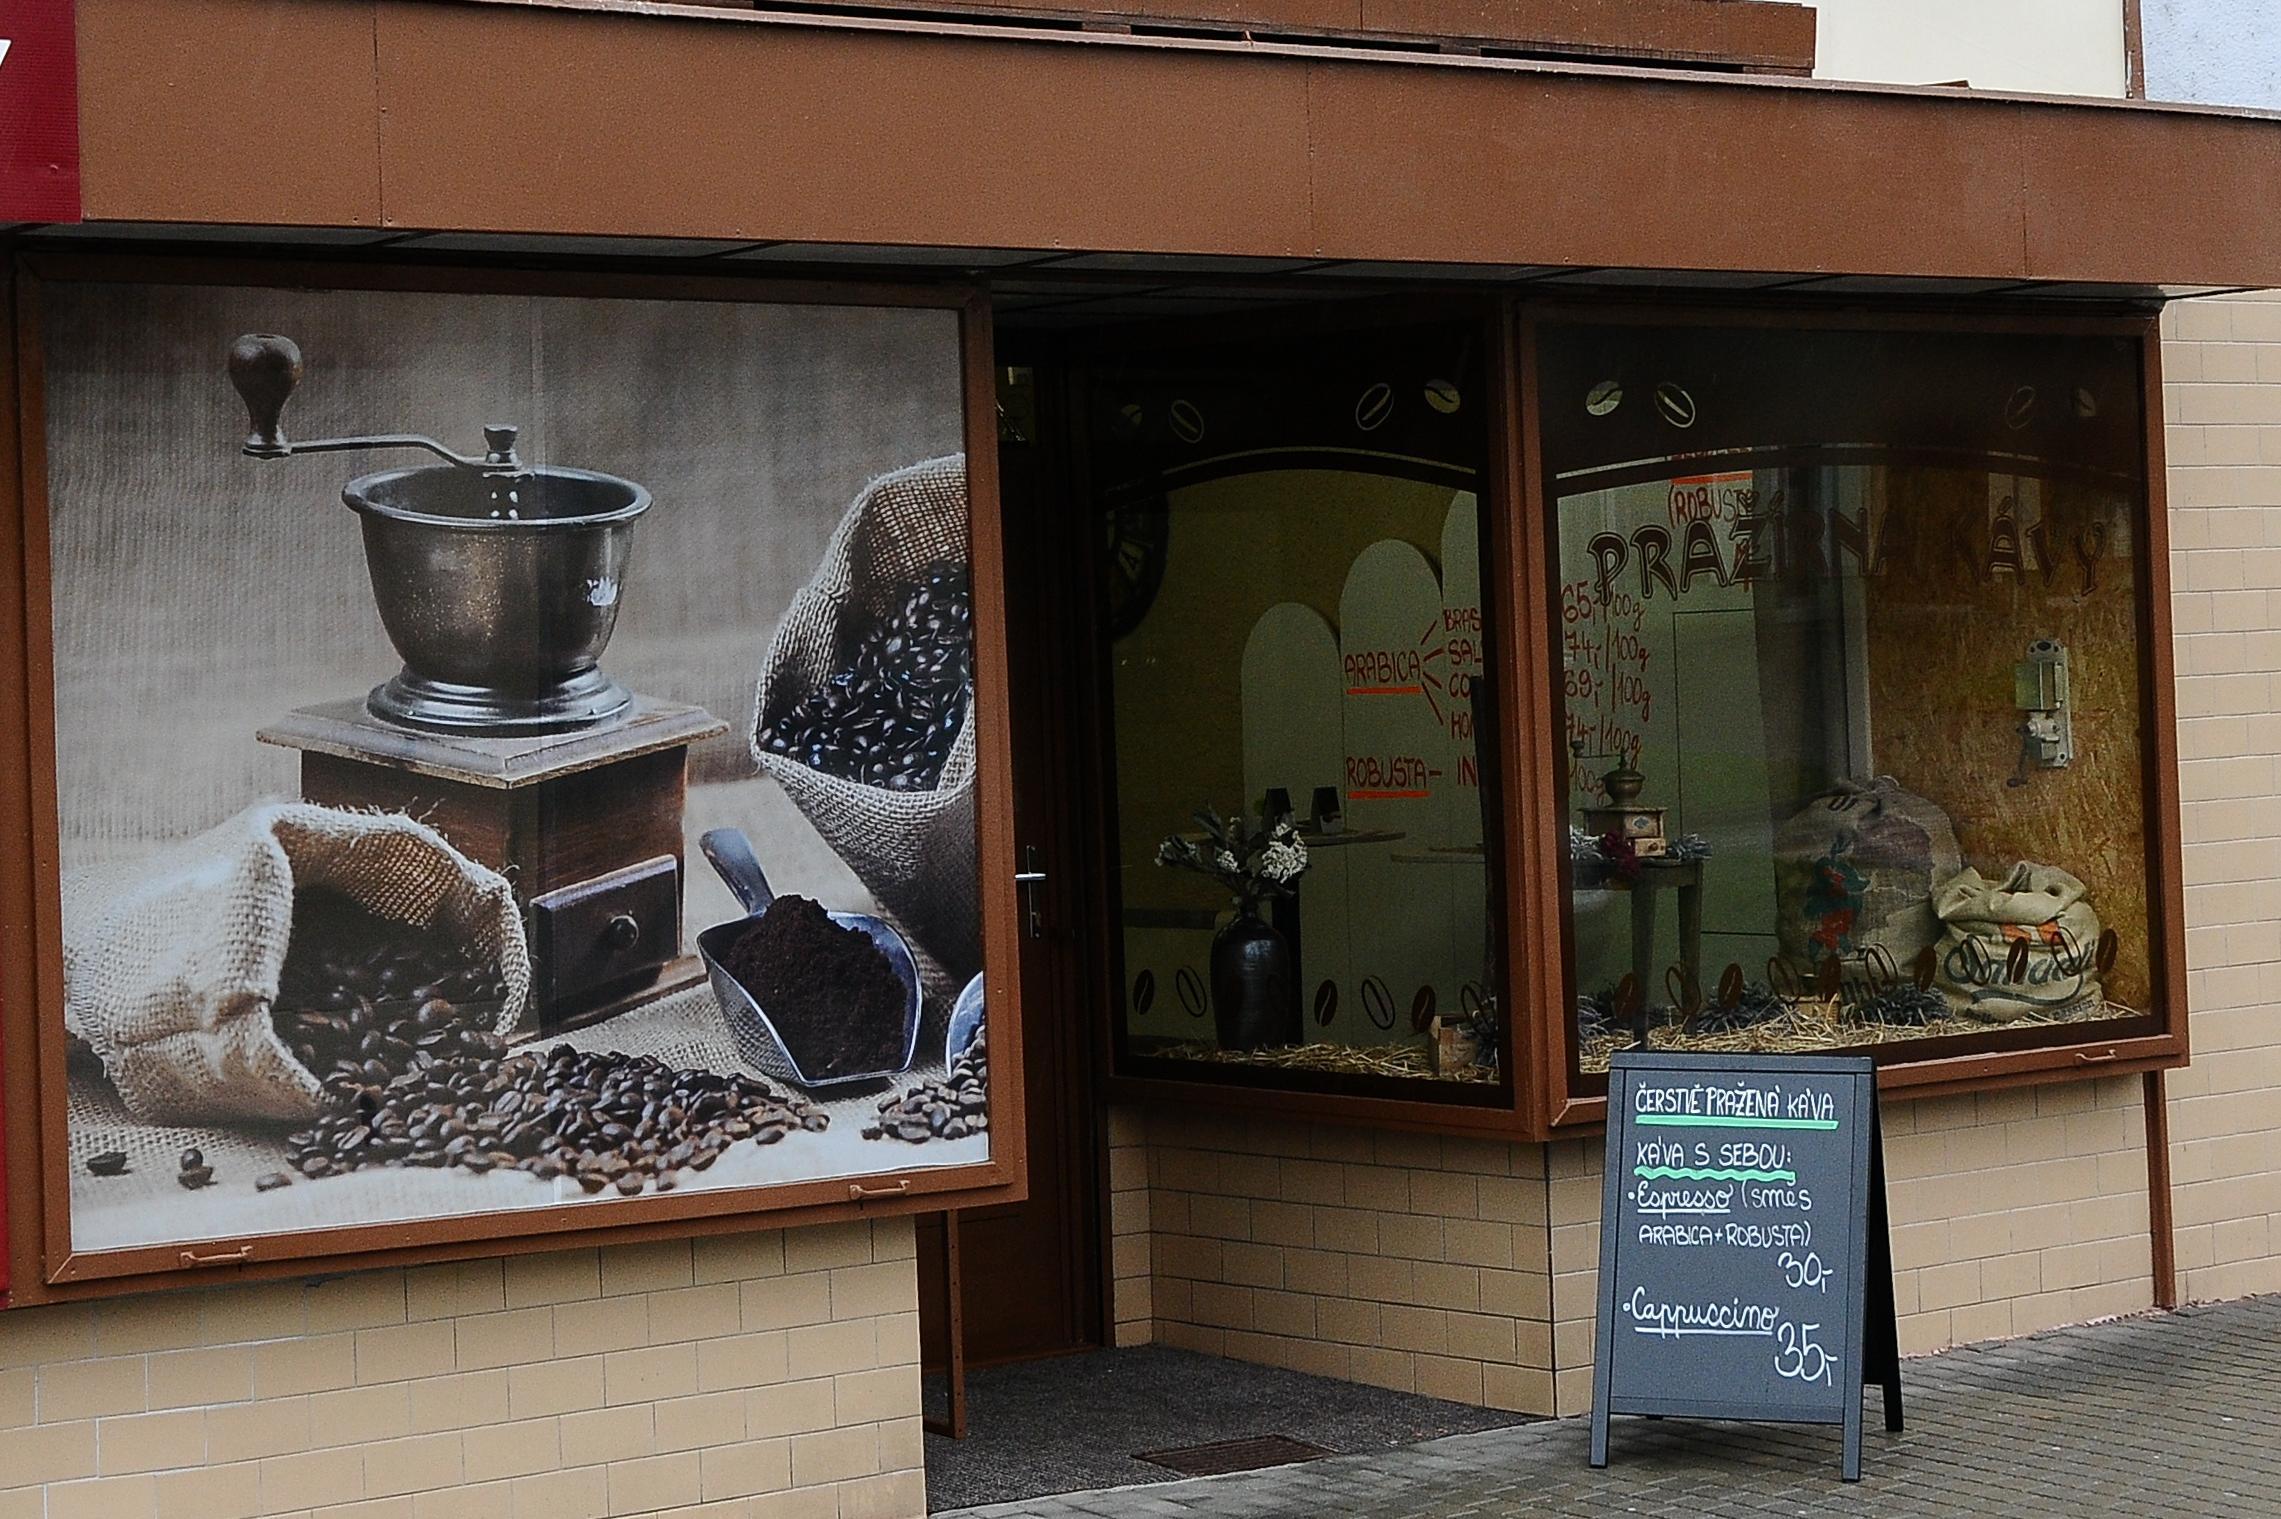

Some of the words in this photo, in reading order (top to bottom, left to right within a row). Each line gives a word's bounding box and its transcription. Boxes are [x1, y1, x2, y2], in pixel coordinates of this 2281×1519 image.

[1344, 650, 1421, 688] ARABICA
[1634, 1080, 1704, 1114] ČERSTVĚ
[1705, 1080, 1781, 1118] PRAŽENÁ
[1786, 1087, 1835, 1121] KÁVA
[1636, 1135, 1685, 1168] KÁVA
[1694, 1142, 1710, 1167] S
[1718, 1141, 1792, 1170] SEBOU:
[1636, 1180, 1735, 1220] Espresso
[1631, 1286, 1780, 1339] Cappuccino
